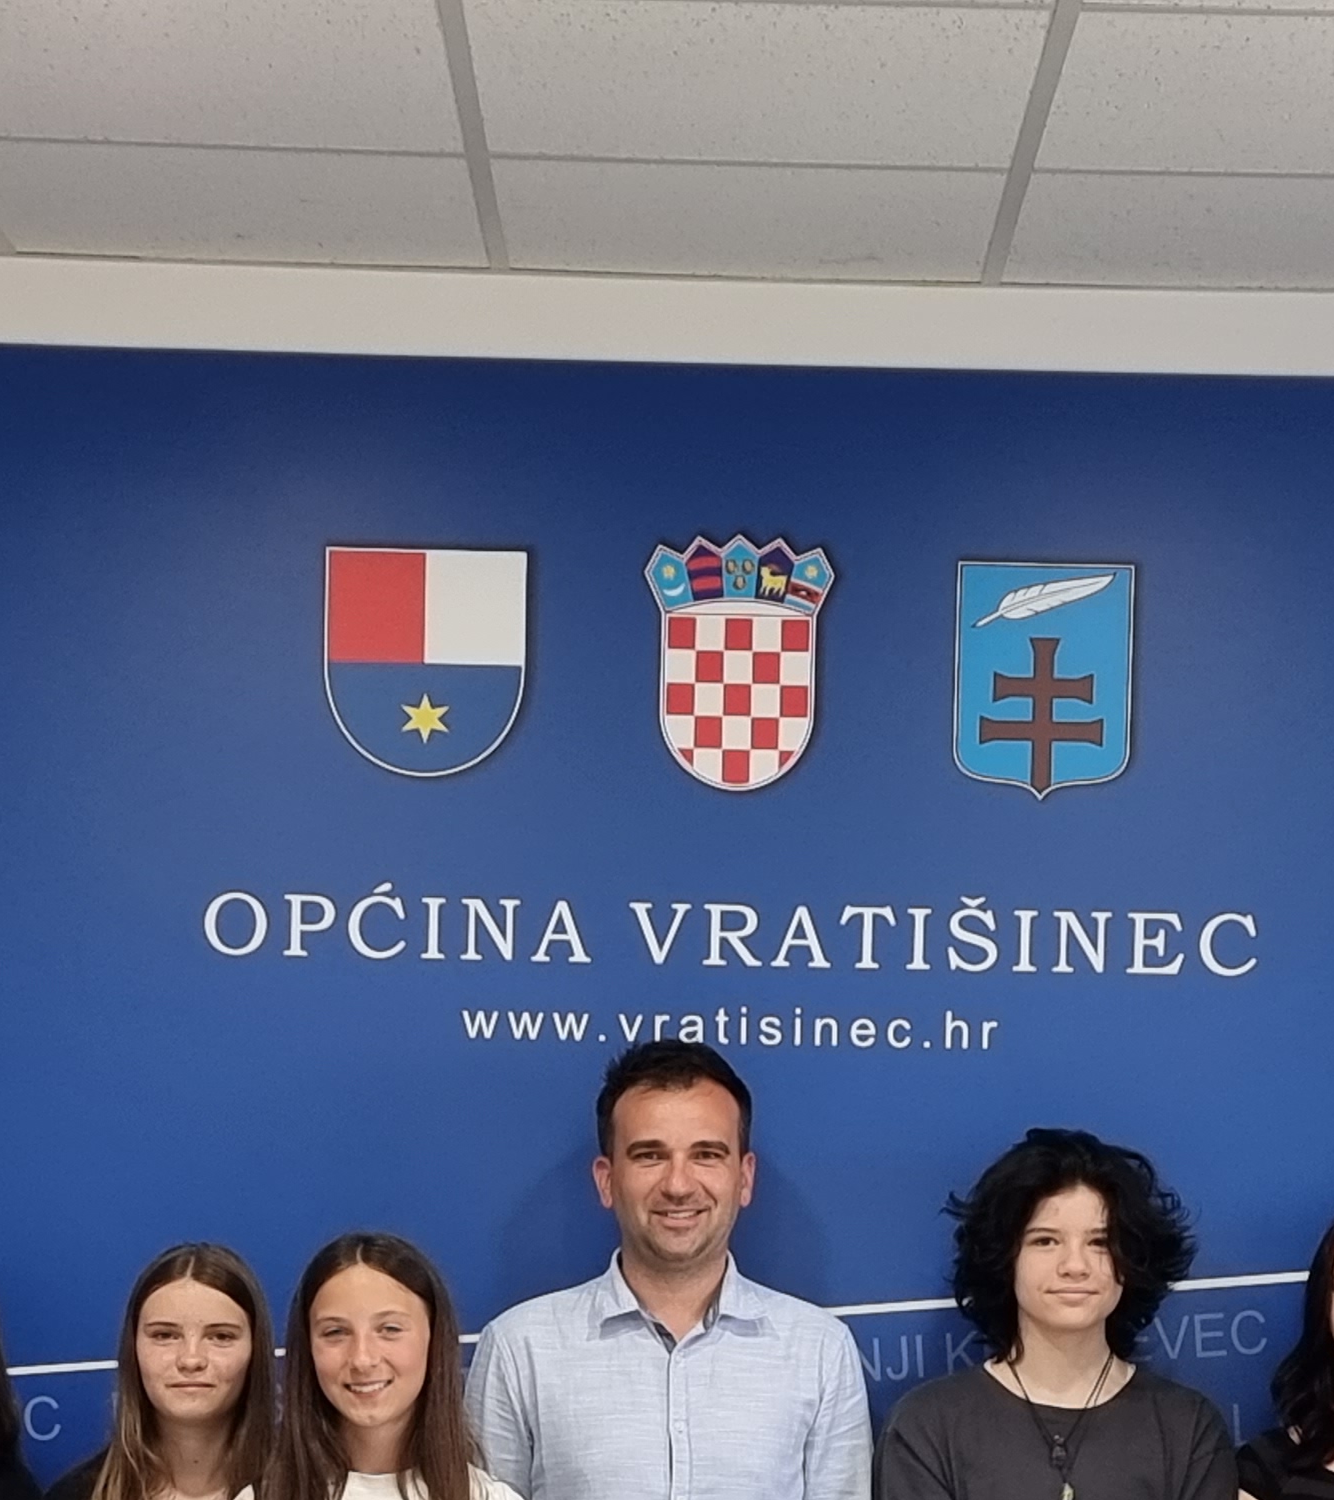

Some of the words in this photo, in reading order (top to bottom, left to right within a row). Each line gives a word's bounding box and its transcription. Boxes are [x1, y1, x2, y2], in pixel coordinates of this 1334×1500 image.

[202, 883, 592, 965] OPĆINA
[629, 896, 1261, 978] VRATIŠINEC
[461, 1003, 1000, 1052] www.vratisinec.hr
[859, 1334, 925, 1382] NJI
